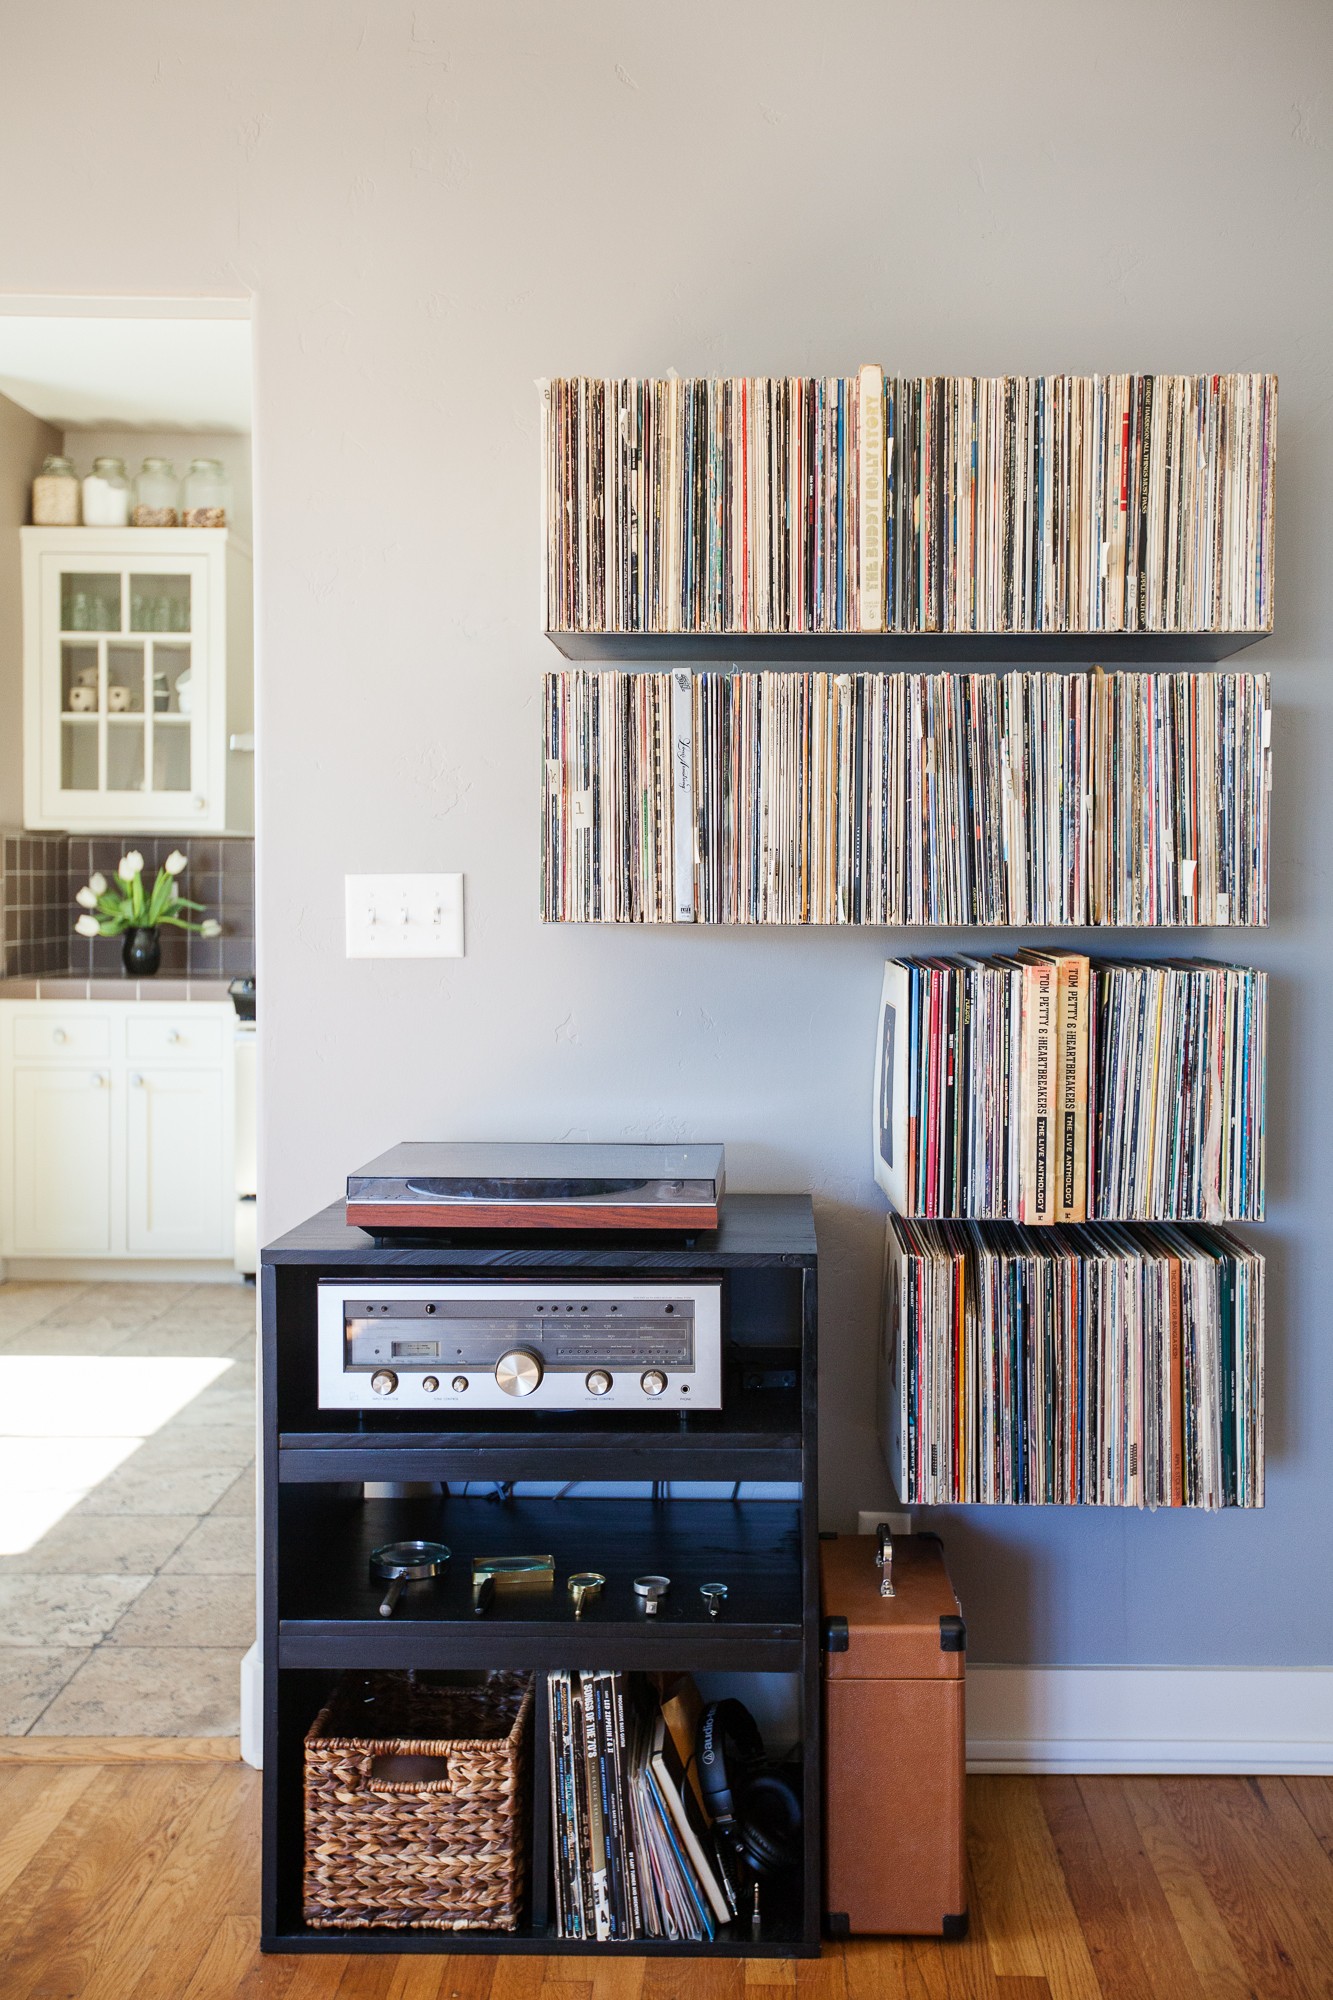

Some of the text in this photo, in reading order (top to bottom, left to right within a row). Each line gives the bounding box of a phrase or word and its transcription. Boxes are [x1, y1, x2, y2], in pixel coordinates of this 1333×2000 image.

[866, 395, 879, 593] THE BUDDY HOLLY STORY
[1039, 973, 1050, 993] TOM
[1068, 968, 1079, 988] TOM
[1039, 996, 1049, 1026] PETTY
[1067, 990, 1078, 1021] PETTY
[1037, 1039, 1048, 1115] HEARTBREAKERS
[1065, 1034, 1077, 1109] HEARTBREAKERS
[1037, 1159, 1045, 1210] ANTHOLOGY
[583, 1683, 598, 1758] SONGS OF THE 70'S
[604, 1710, 612, 1737] ZEPPELIN
